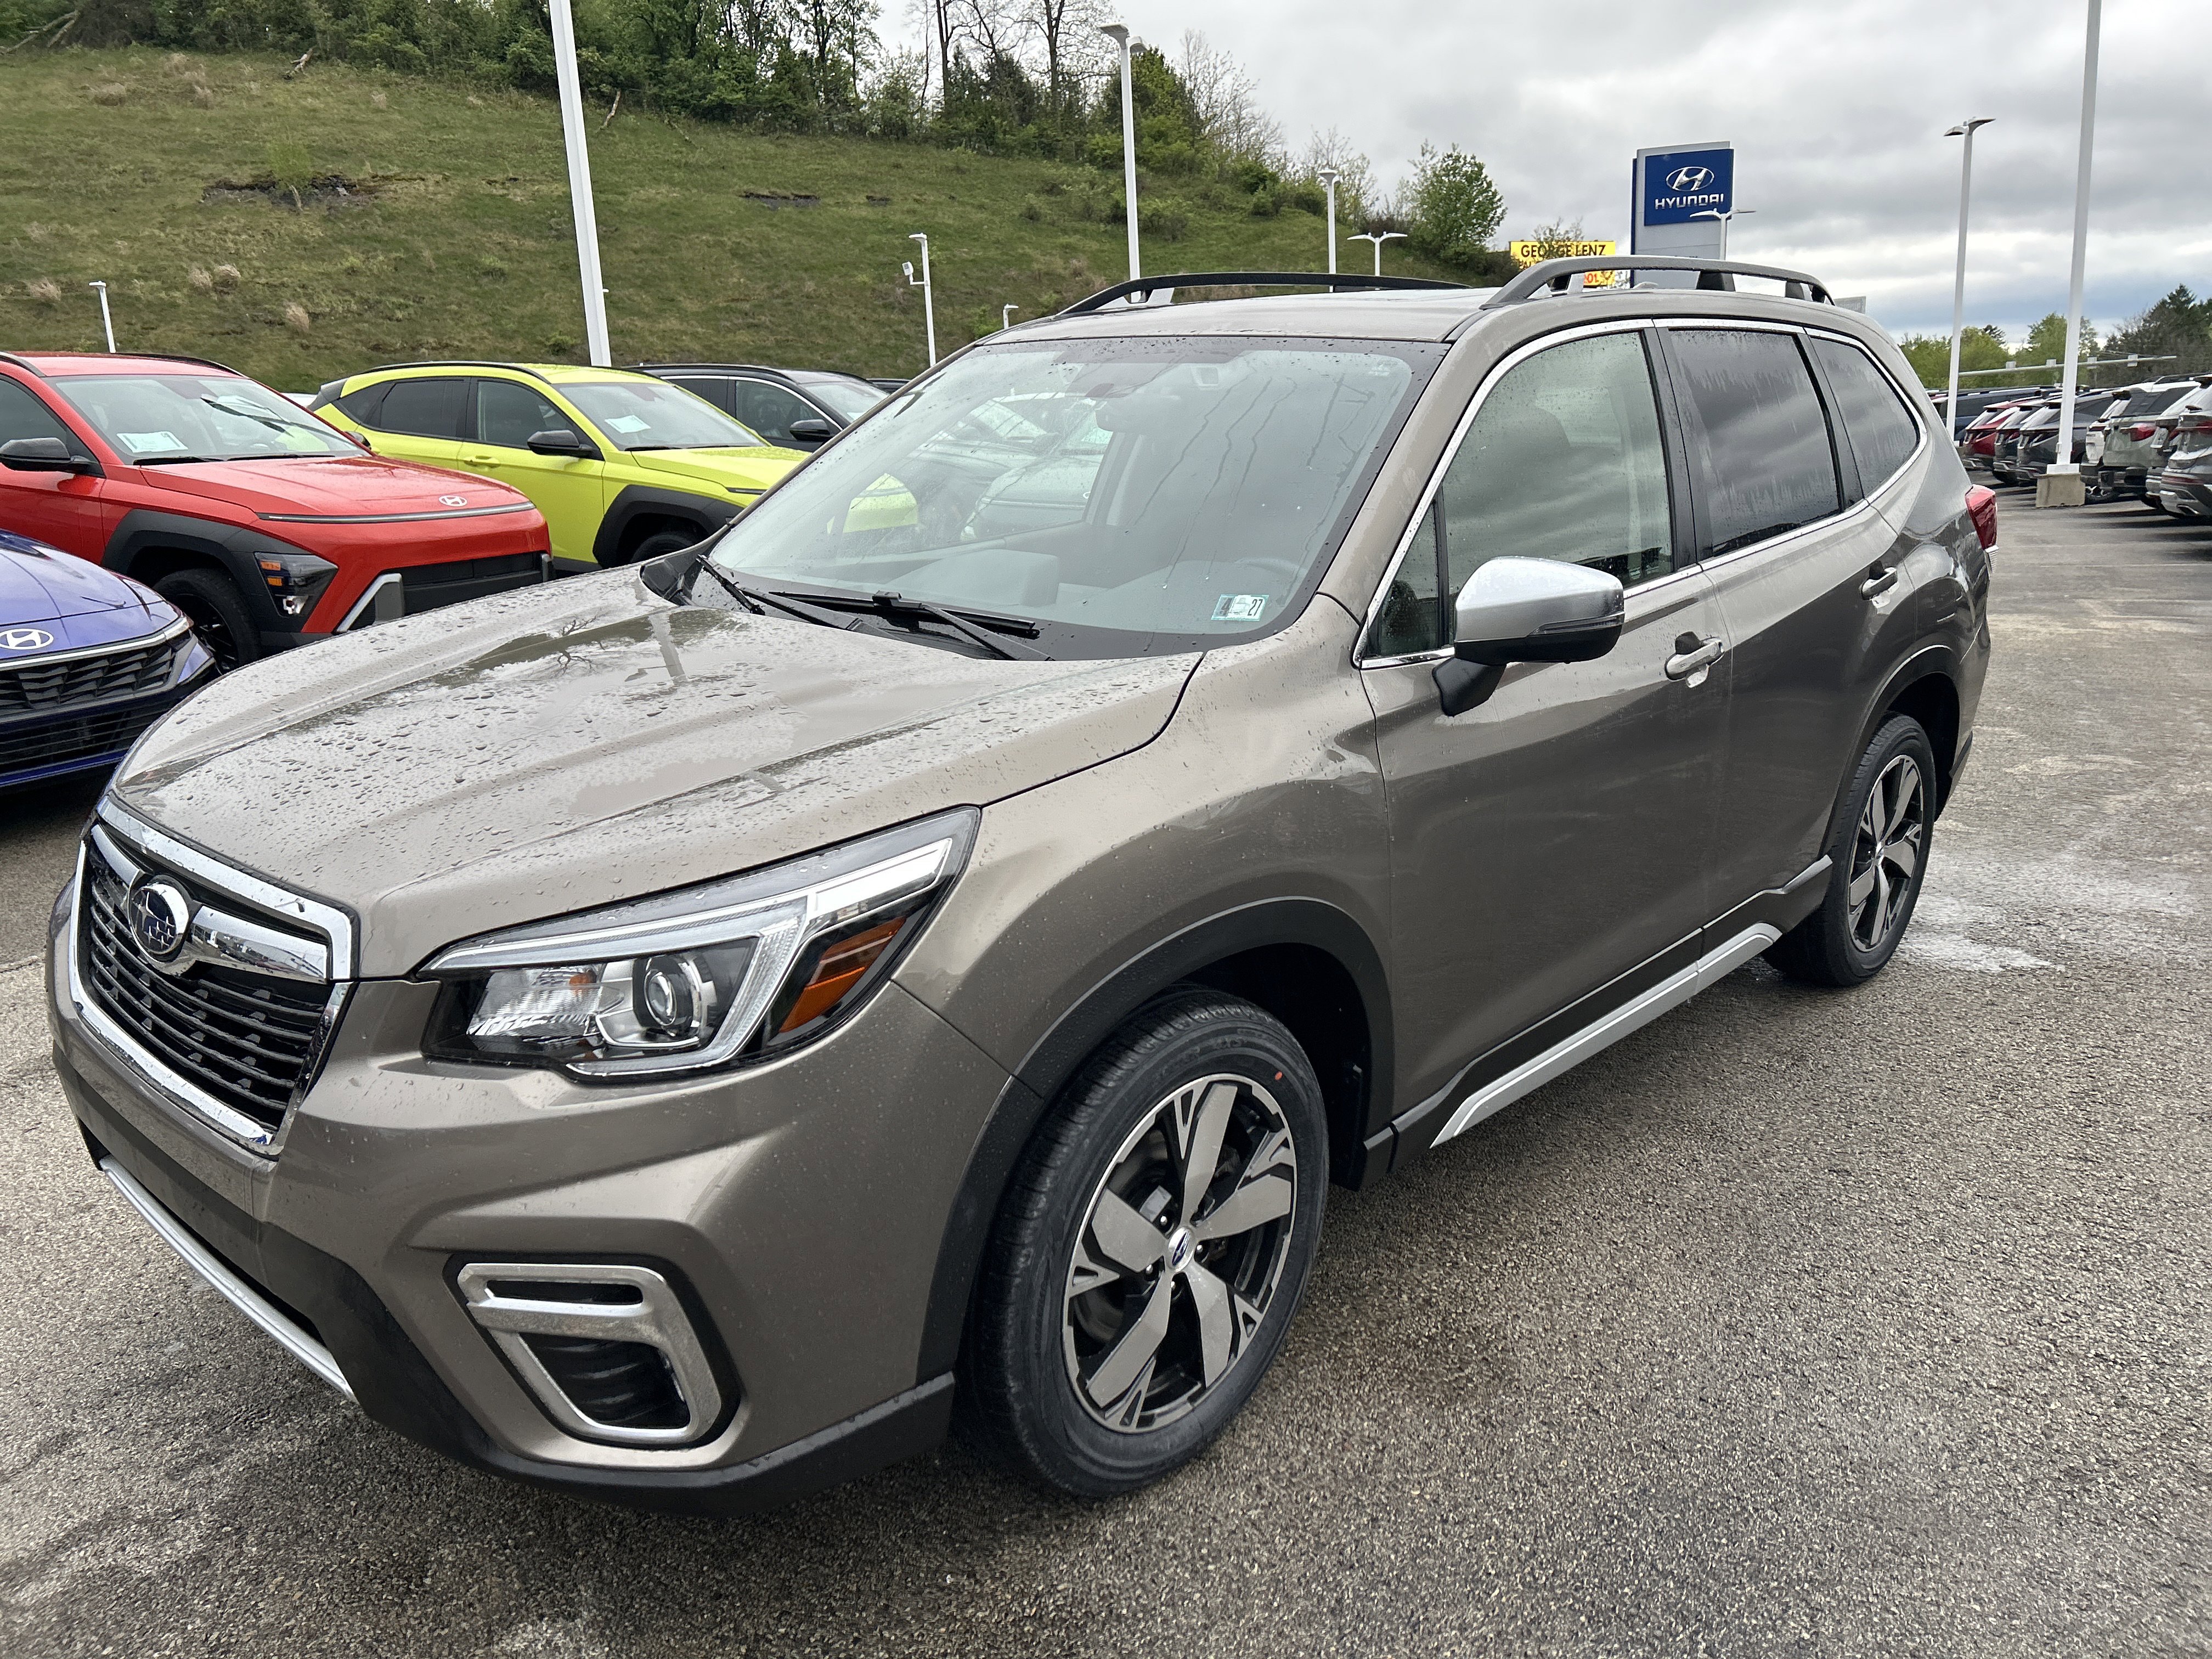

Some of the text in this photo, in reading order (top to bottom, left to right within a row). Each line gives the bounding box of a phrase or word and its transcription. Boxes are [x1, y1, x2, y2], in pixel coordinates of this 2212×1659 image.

[1655, 193, 1724, 210] HYUNDAI
[1576, 244, 1606, 256] LENZ
[1247, 599, 1263, 617] 27
